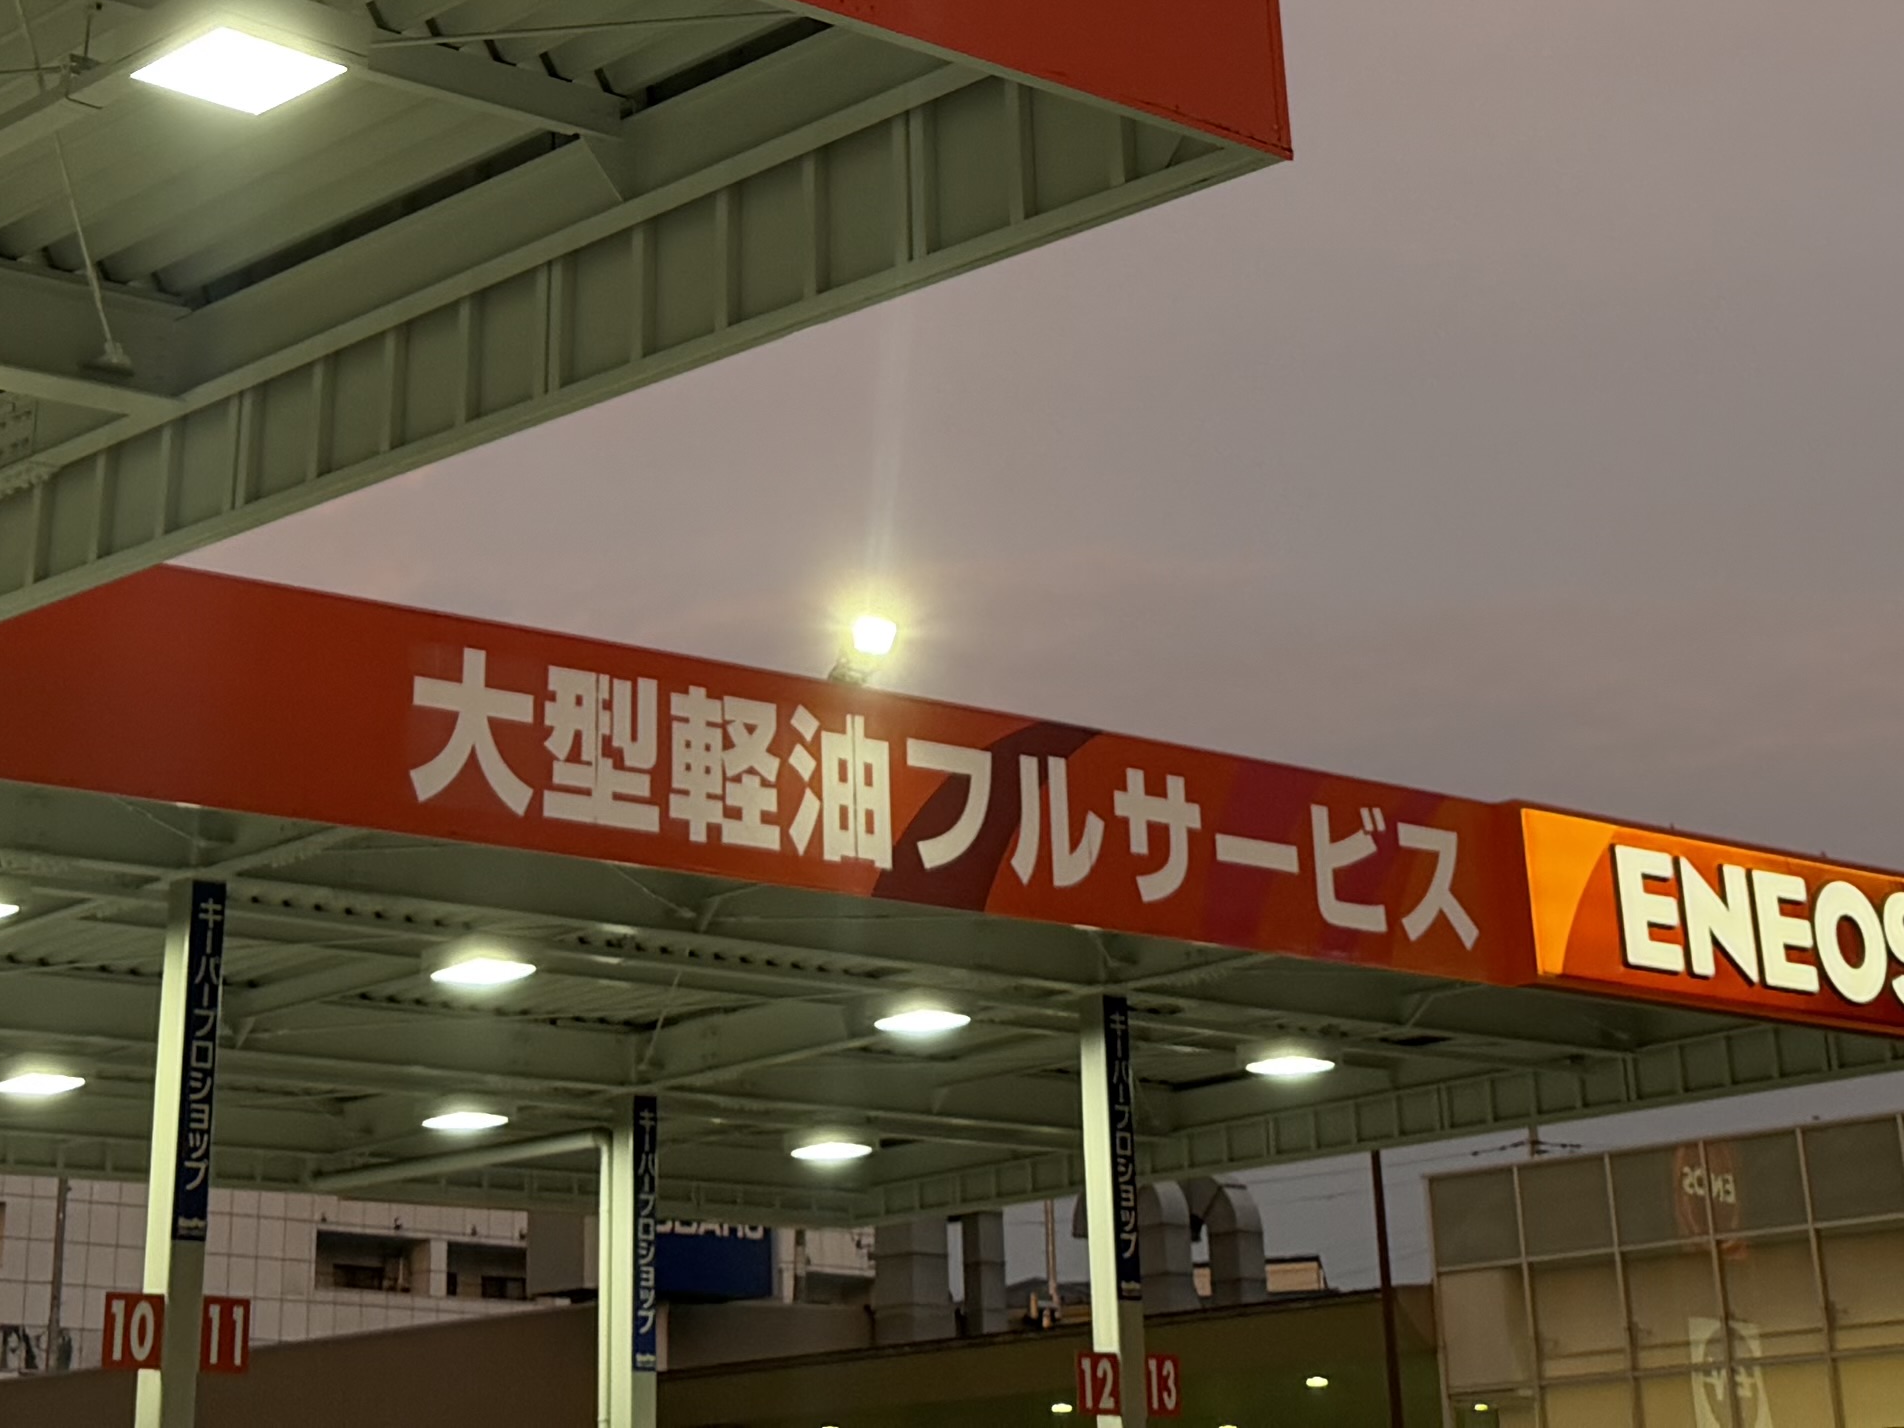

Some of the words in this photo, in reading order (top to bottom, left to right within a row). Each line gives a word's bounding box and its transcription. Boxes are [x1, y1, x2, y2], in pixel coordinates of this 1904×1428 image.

[409, 647, 1481, 951] 大型軽油フルサービス
[111, 1299, 155, 1361] 10
[209, 1303, 244, 1366] 11
[1081, 1357, 1114, 1411] 12
[1148, 1357, 1177, 1411] 13
